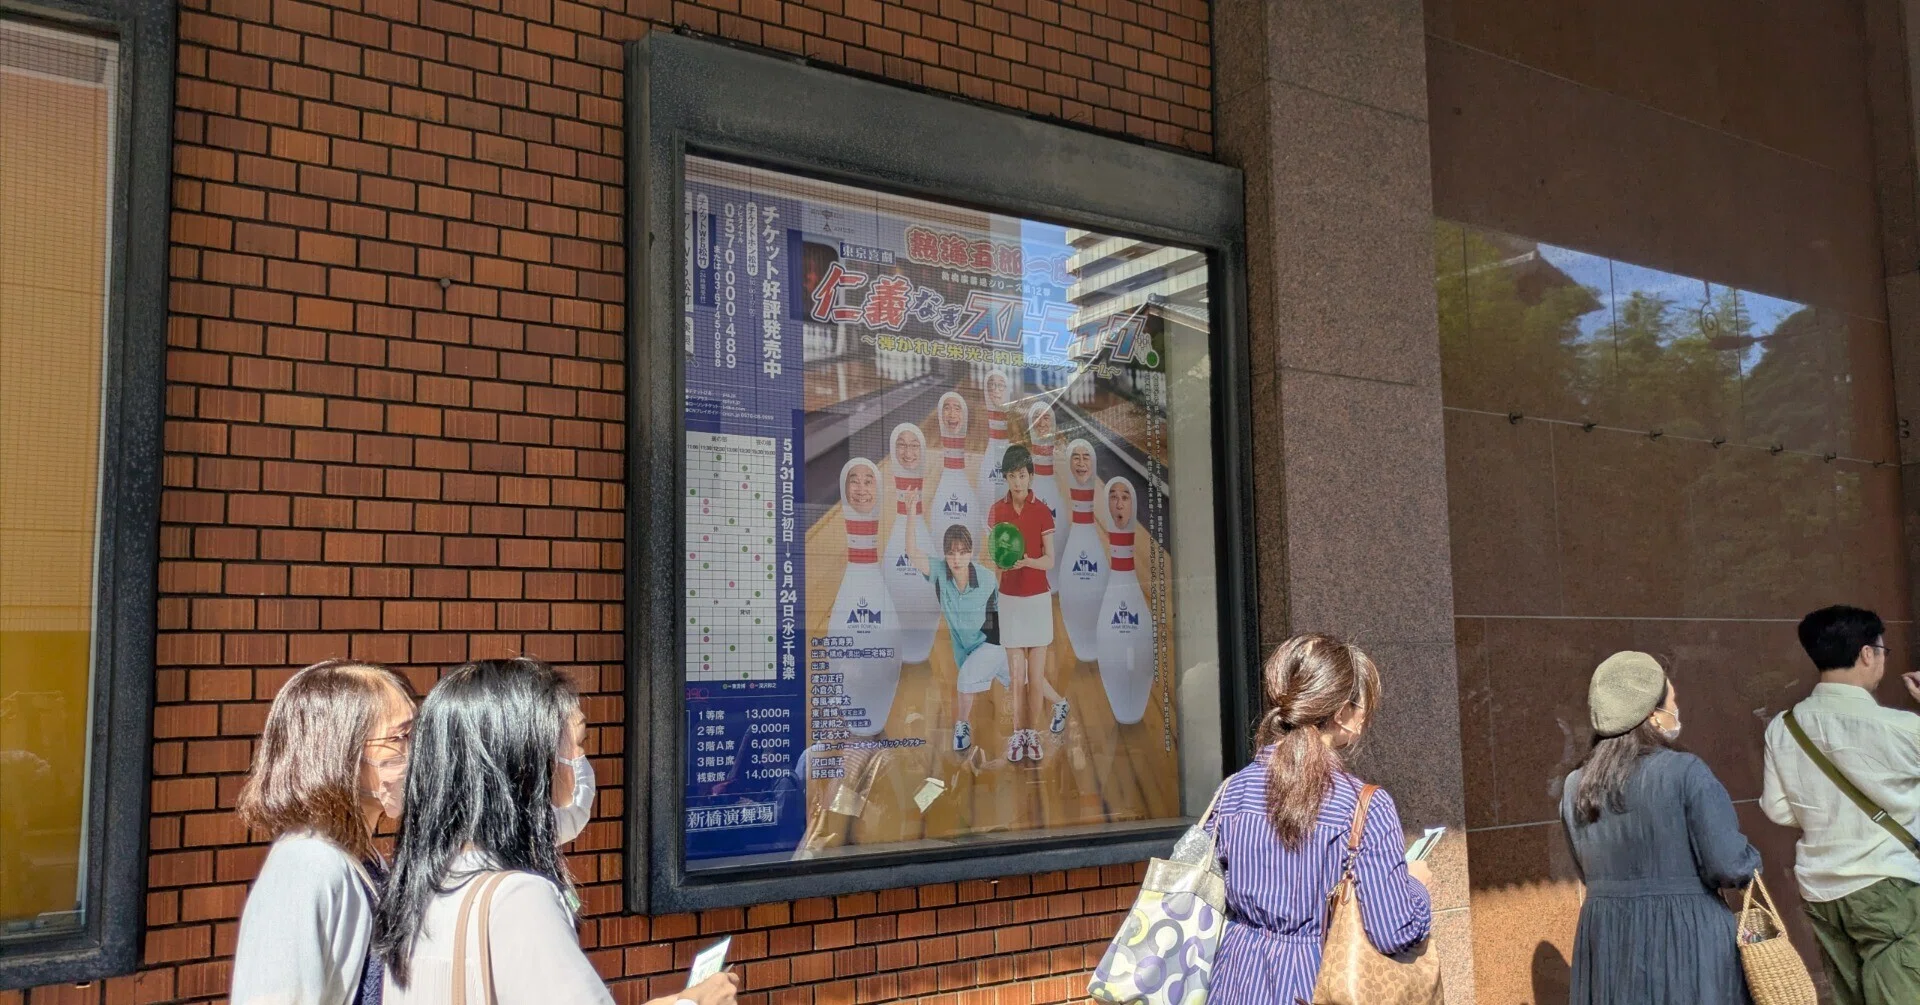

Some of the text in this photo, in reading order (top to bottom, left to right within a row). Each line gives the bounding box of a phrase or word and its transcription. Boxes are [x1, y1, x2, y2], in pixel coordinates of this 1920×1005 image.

[842, 245, 893, 264] 東京喜劇
[725, 203, 736, 369] 0570-000-489
[762, 206, 782, 379] チケット好評発売中
[780, 438, 794, 542] 5月31日(日)初日
[1072, 559, 1098, 573] ATM
[846, 608, 881, 624] ATM
[1111, 611, 1139, 625] ATM
[699, 708, 790, 720] 1等席 13,000円
[697, 723, 790, 736] 2等席 9,000円
[697, 738, 790, 751] 3階A席 6,000円
[697, 753, 790, 767] 3階B席 3,500円
[812, 757, 844, 767] 沢口靖子
[745, 768, 790, 779] 14,000円
[812, 769, 844, 779] 野呂佳代
[687, 806, 773, 828] 新橋演舞場
